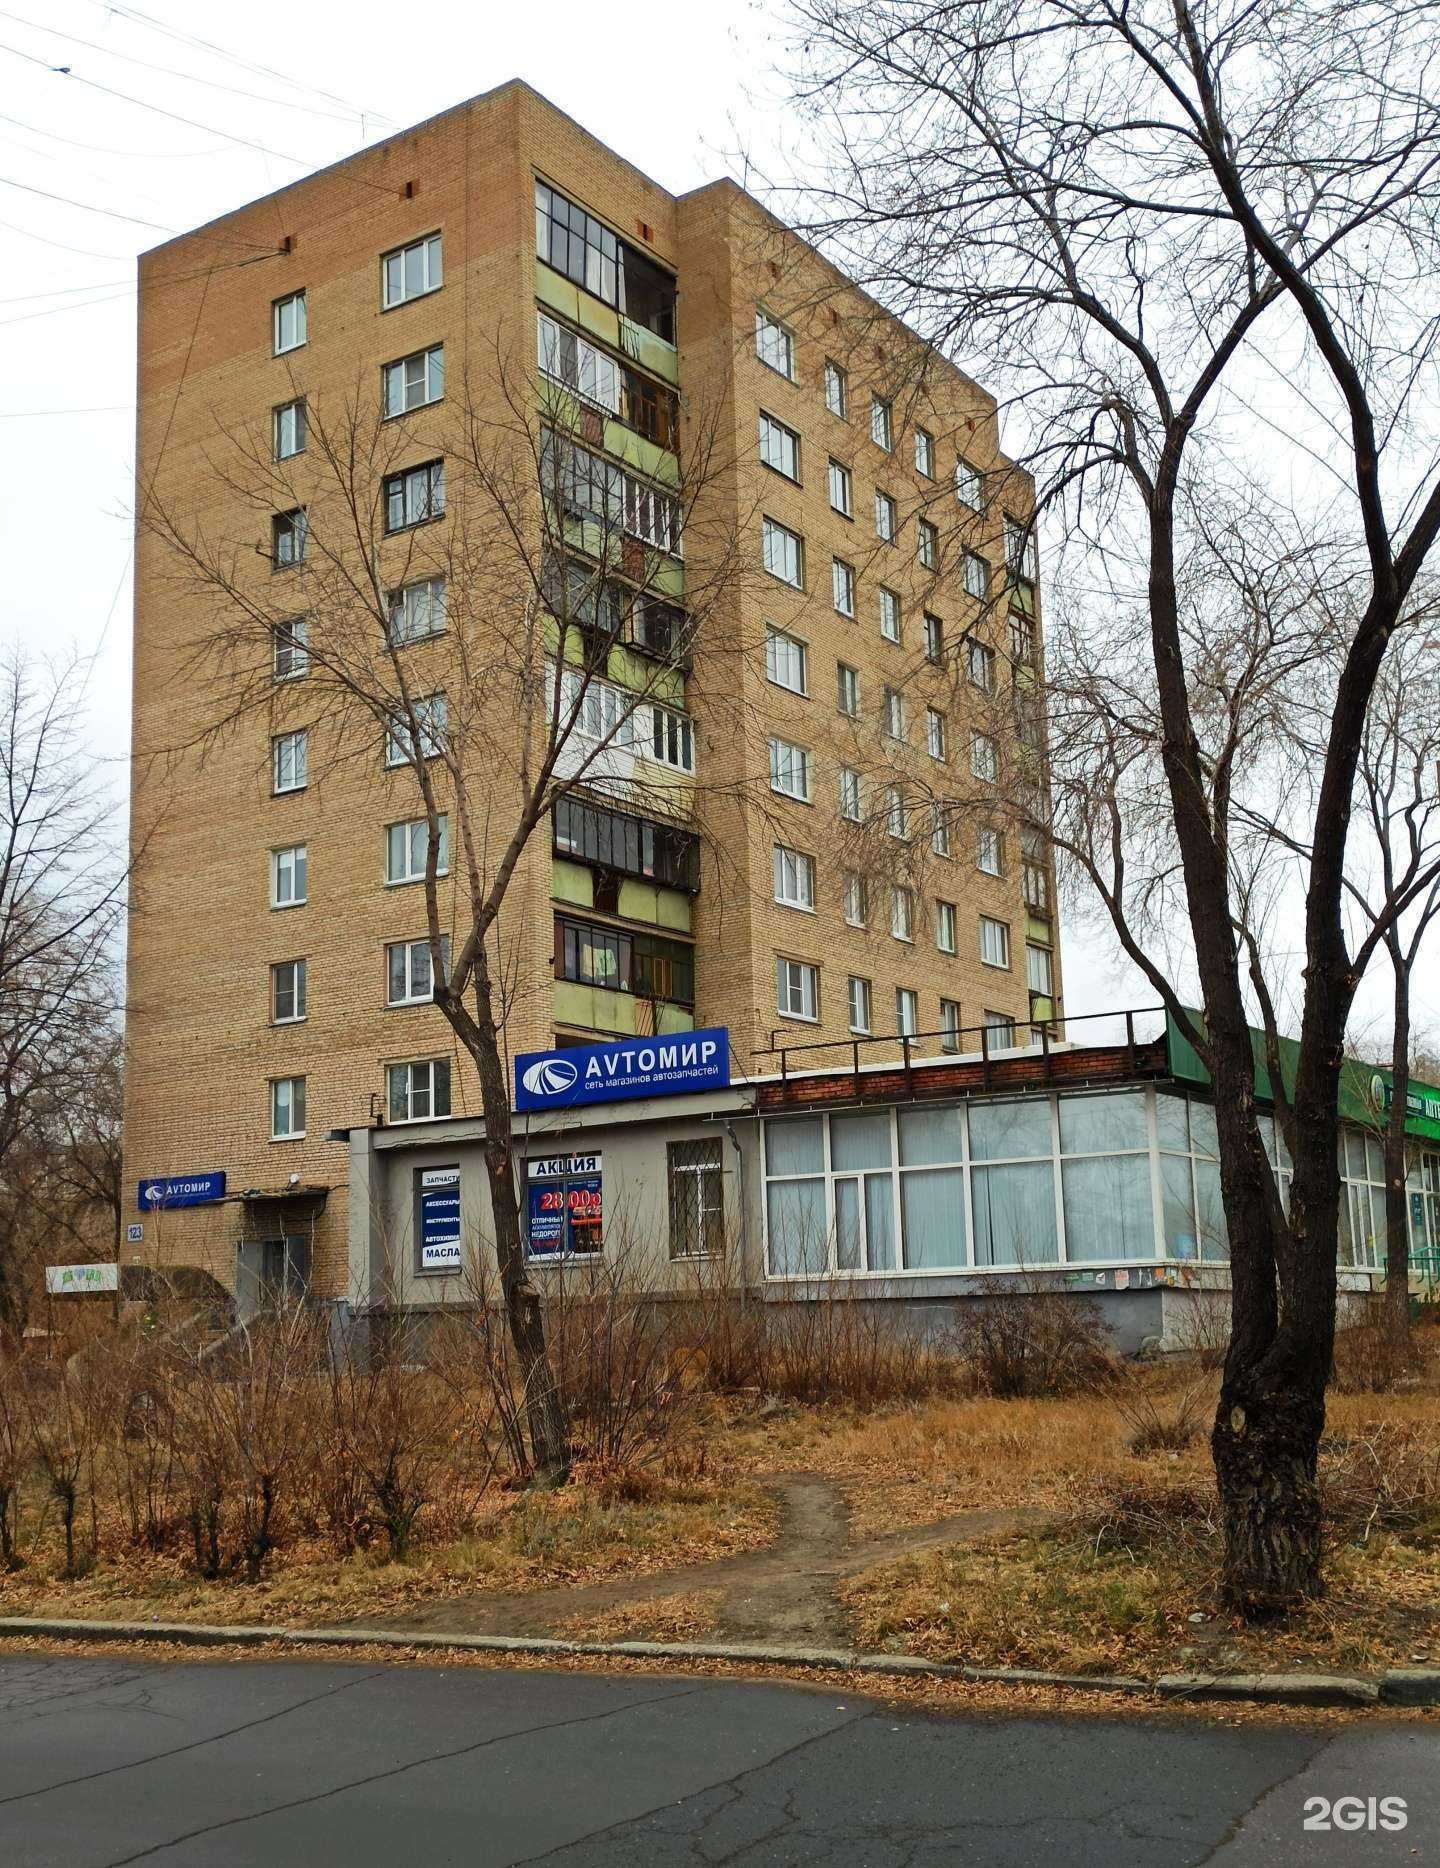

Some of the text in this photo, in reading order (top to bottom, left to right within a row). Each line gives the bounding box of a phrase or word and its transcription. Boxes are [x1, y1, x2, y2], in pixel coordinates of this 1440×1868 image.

[585, 1065, 719, 1090] сеть магазинов автозапчастей
[536, 1157, 596, 1175] АКЦИЯ
[426, 1248, 460, 1258] МАСЛА
